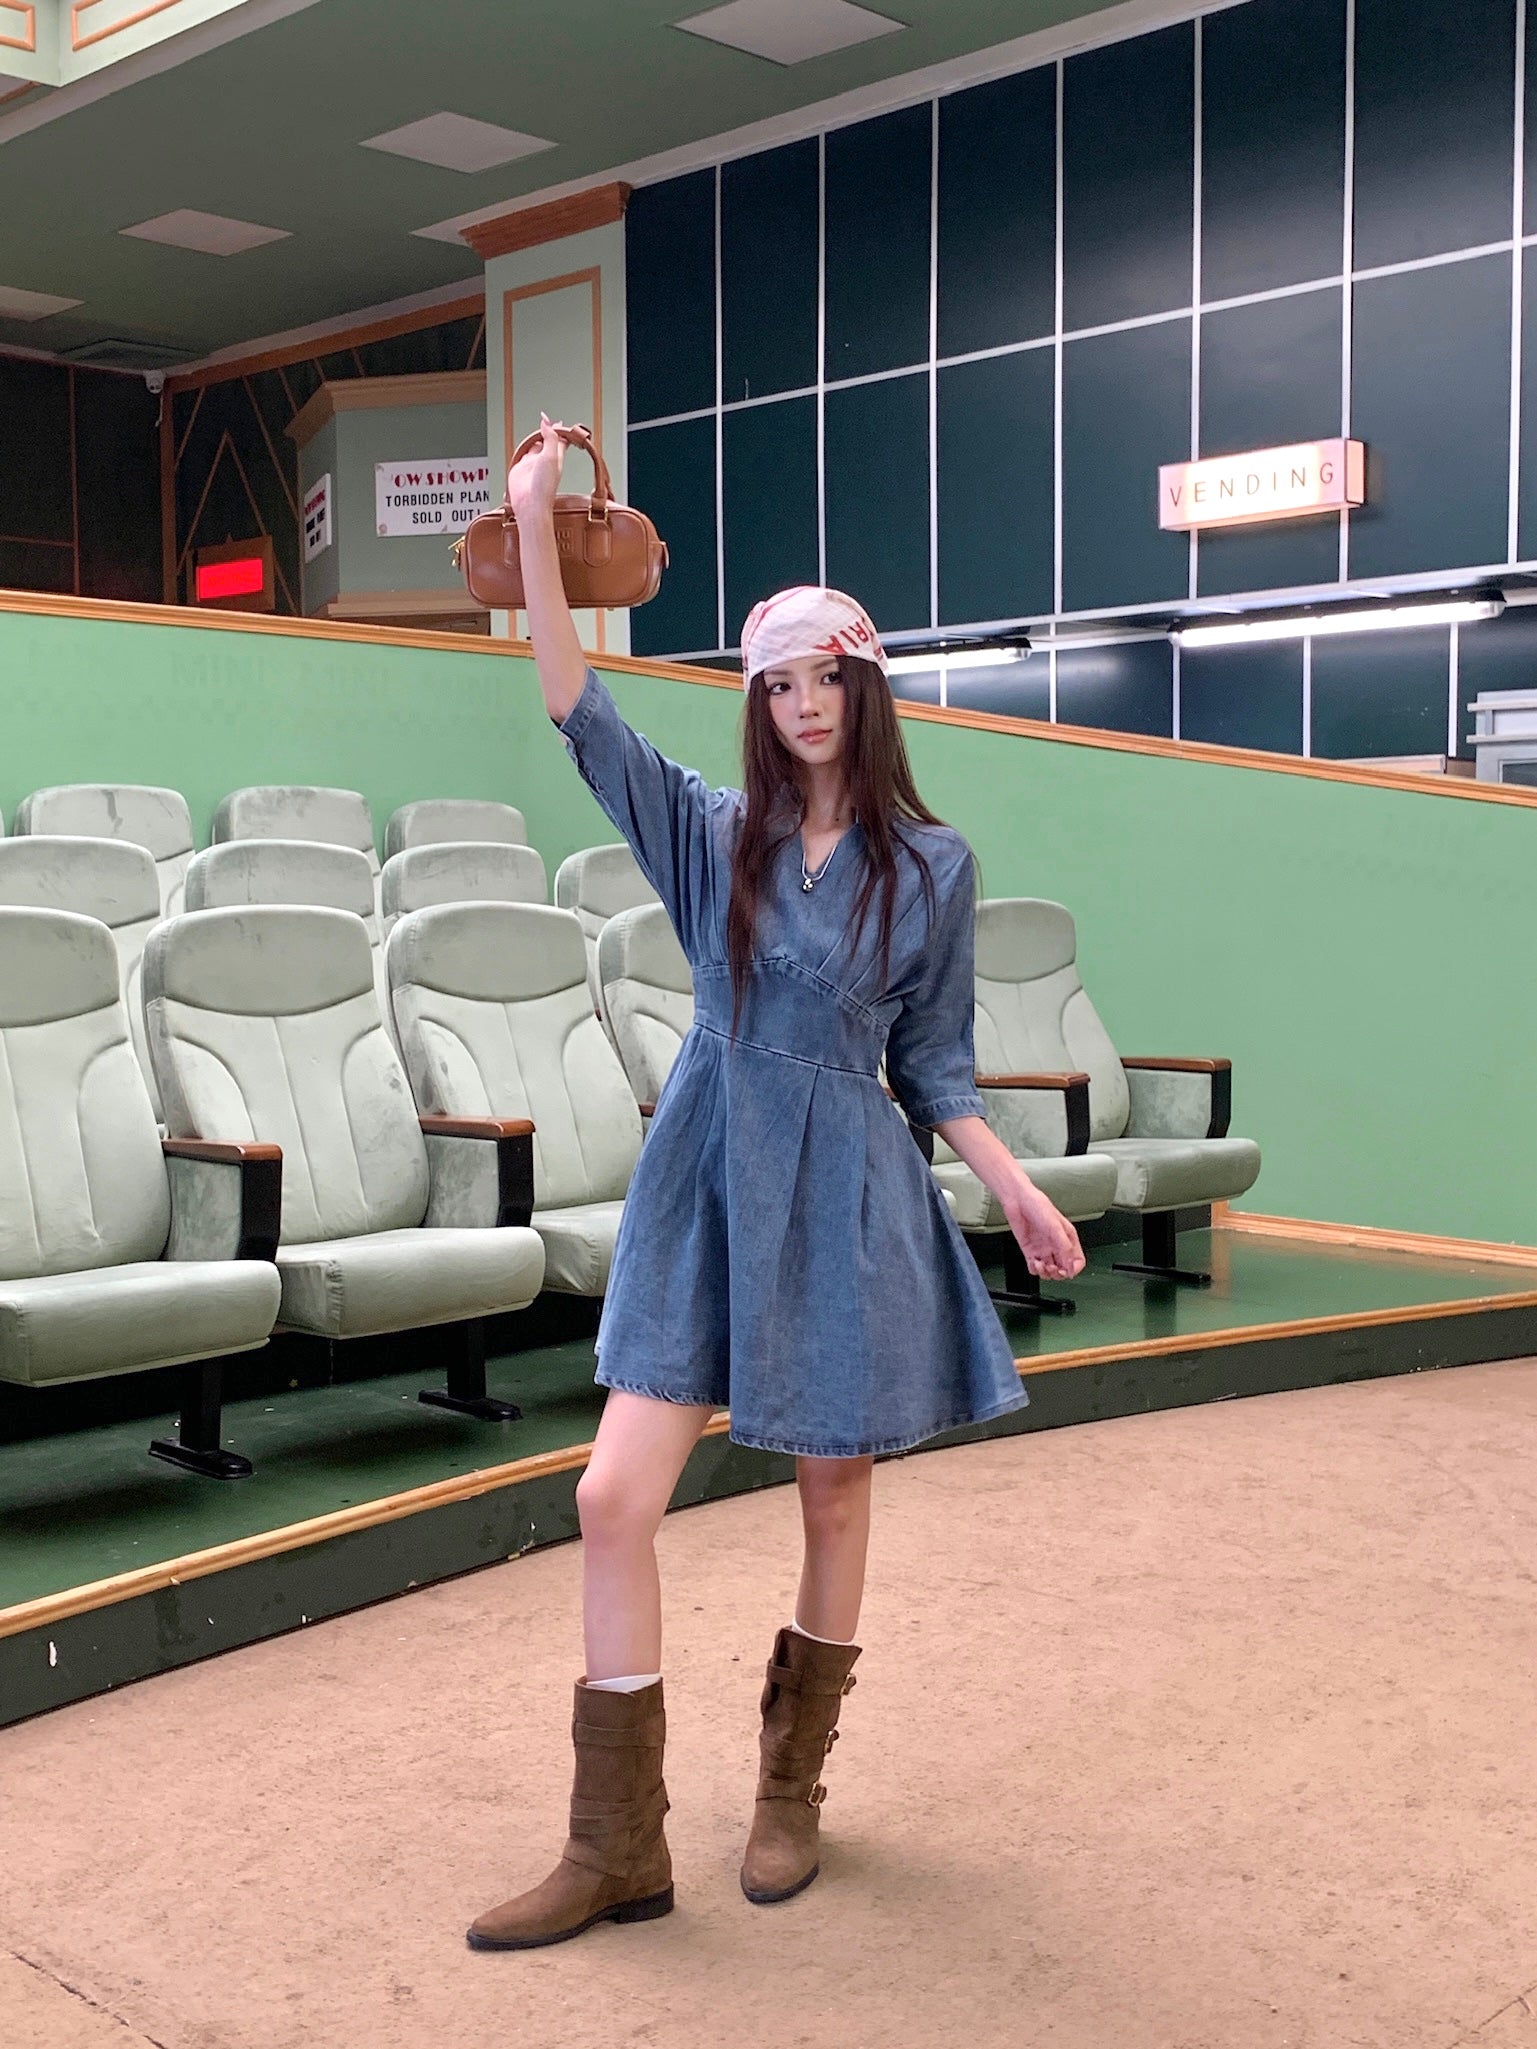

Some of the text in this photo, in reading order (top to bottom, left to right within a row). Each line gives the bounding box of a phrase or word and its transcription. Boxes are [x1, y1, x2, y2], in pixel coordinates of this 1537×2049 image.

[390, 472, 423, 488] OW
[1169, 462, 1334, 507] VENDING
[385, 492, 453, 507] TORBIDDEN
[412, 511, 442, 524] SOLD
